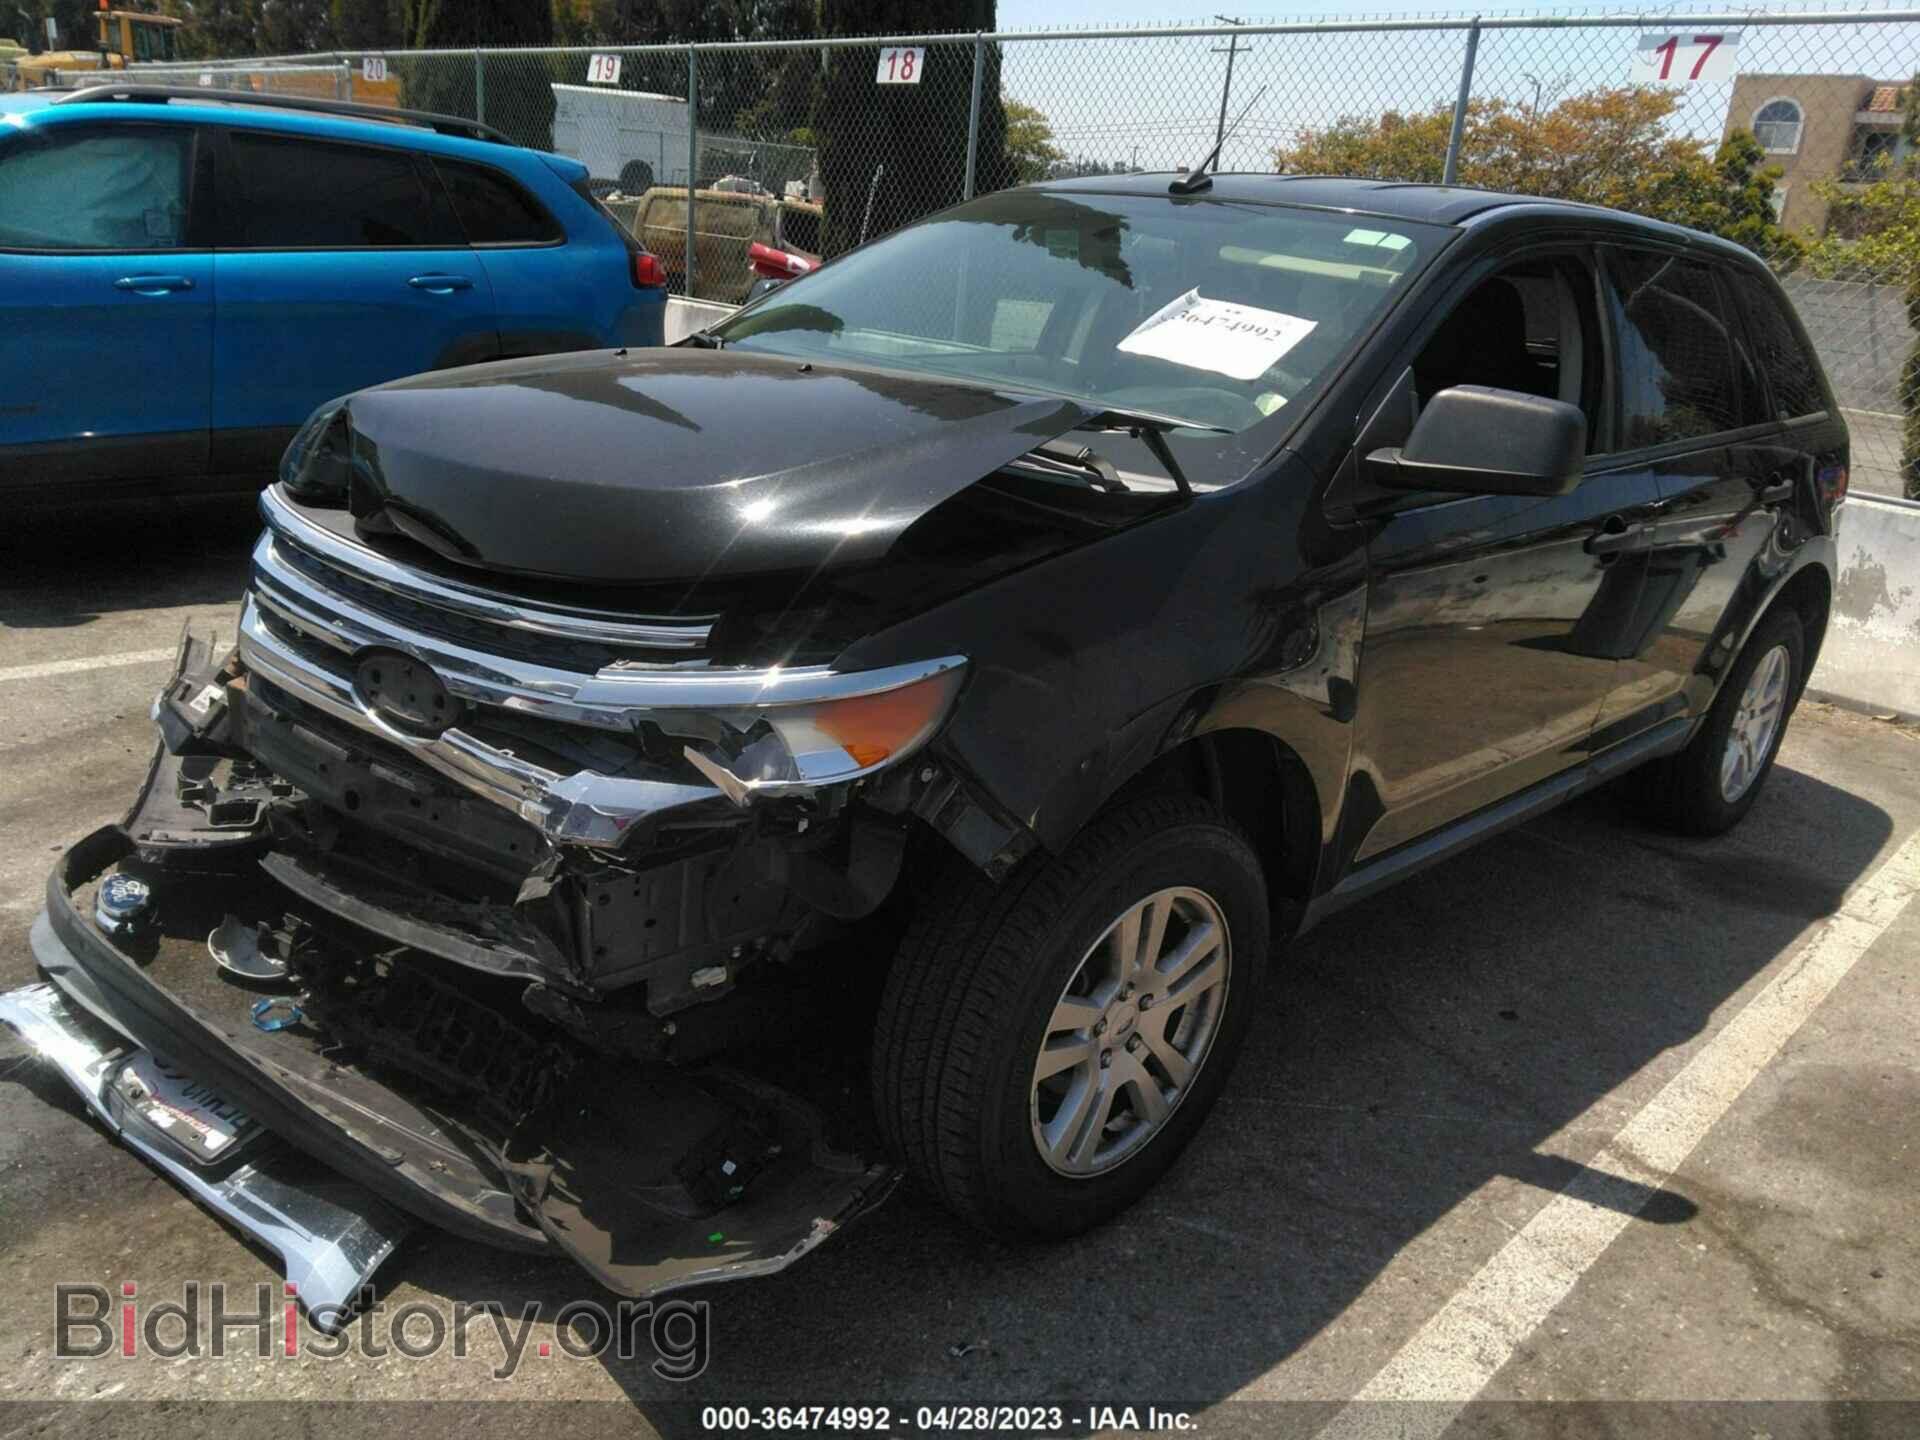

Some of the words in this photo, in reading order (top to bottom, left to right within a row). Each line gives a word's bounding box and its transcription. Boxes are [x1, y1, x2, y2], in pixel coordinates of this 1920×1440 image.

[367, 59, 384, 79] 20
[595, 55, 615, 80] 19
[887, 50, 915, 80] 18
[1656, 33, 1724, 80] 17
